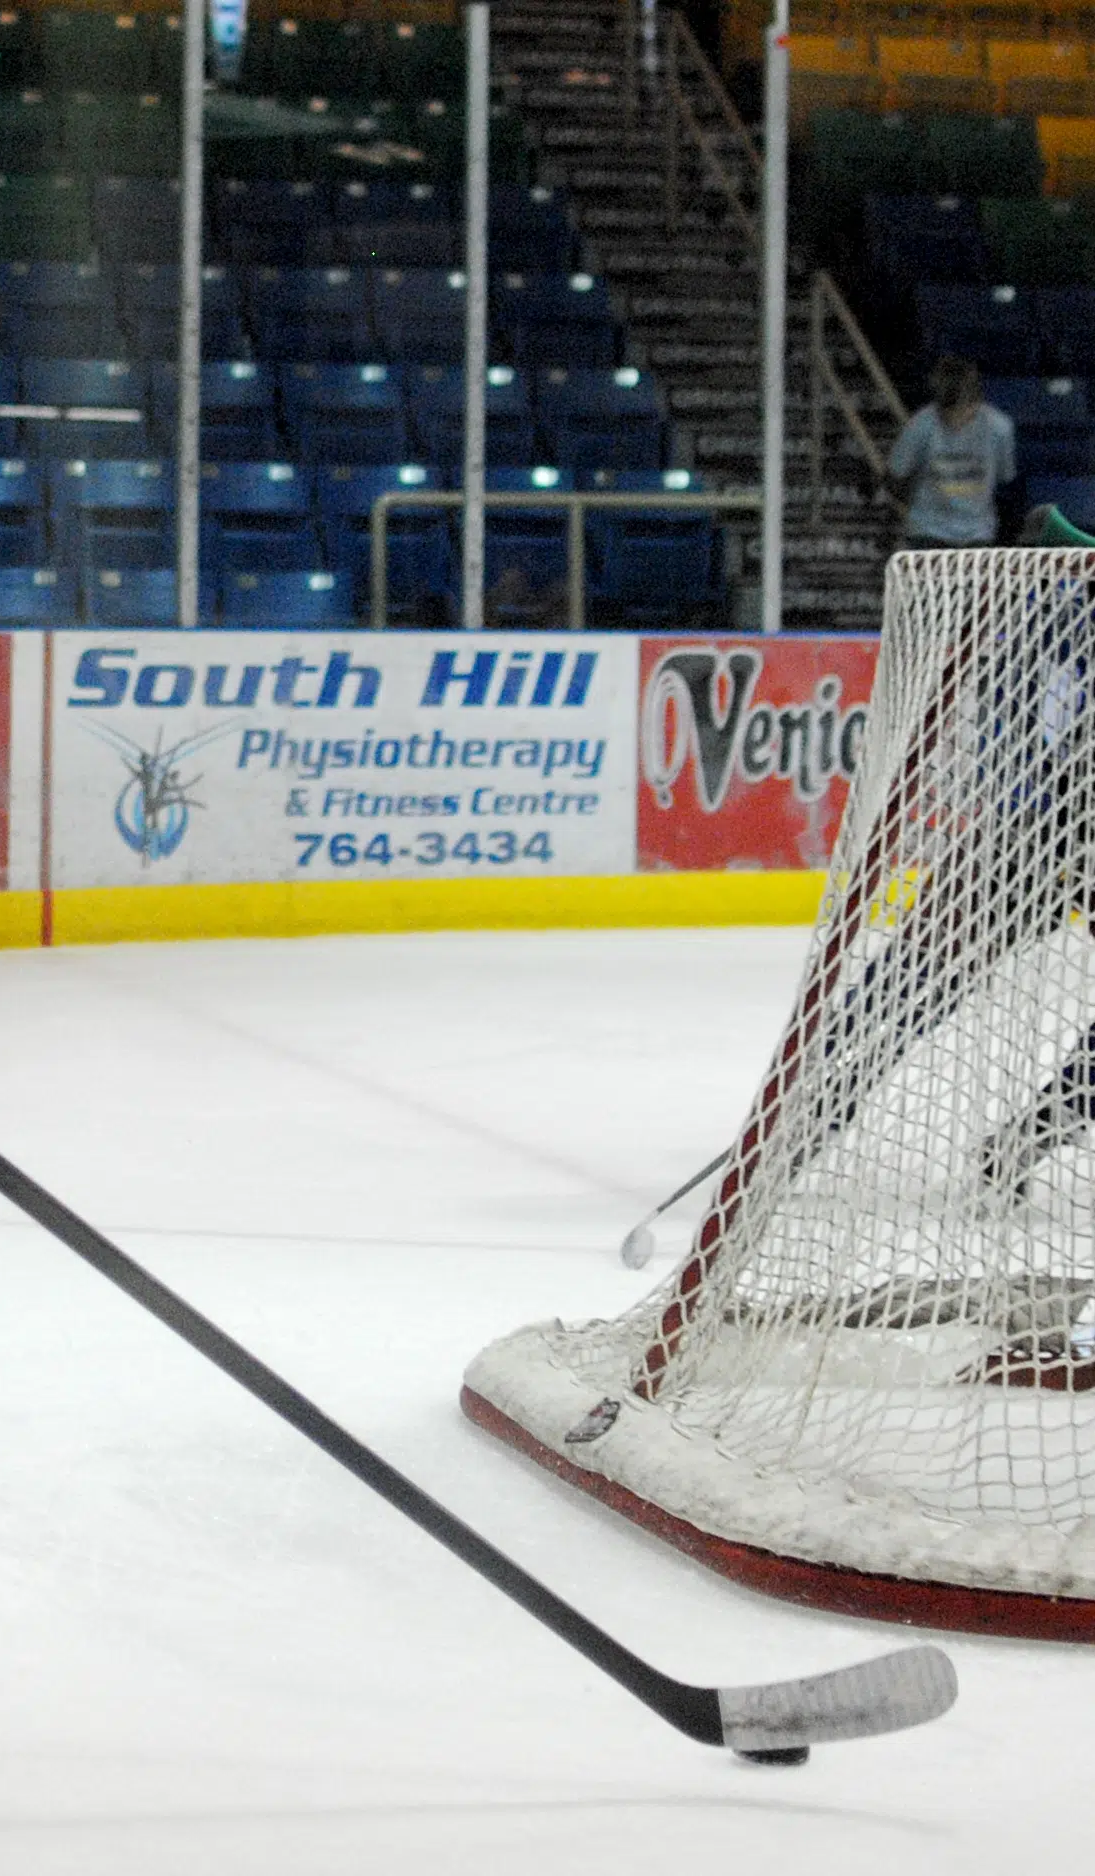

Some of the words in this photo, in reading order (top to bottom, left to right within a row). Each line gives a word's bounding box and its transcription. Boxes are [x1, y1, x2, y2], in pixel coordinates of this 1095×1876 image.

[66, 647, 382, 708] South
[419, 650, 599, 708] Hill
[237, 727, 608, 778] Physiotherapy
[285, 787, 308, 817] &
[321, 786, 460, 817] Fitness
[471, 787, 600, 817] Centre
[294, 831, 554, 867] 764-3434
